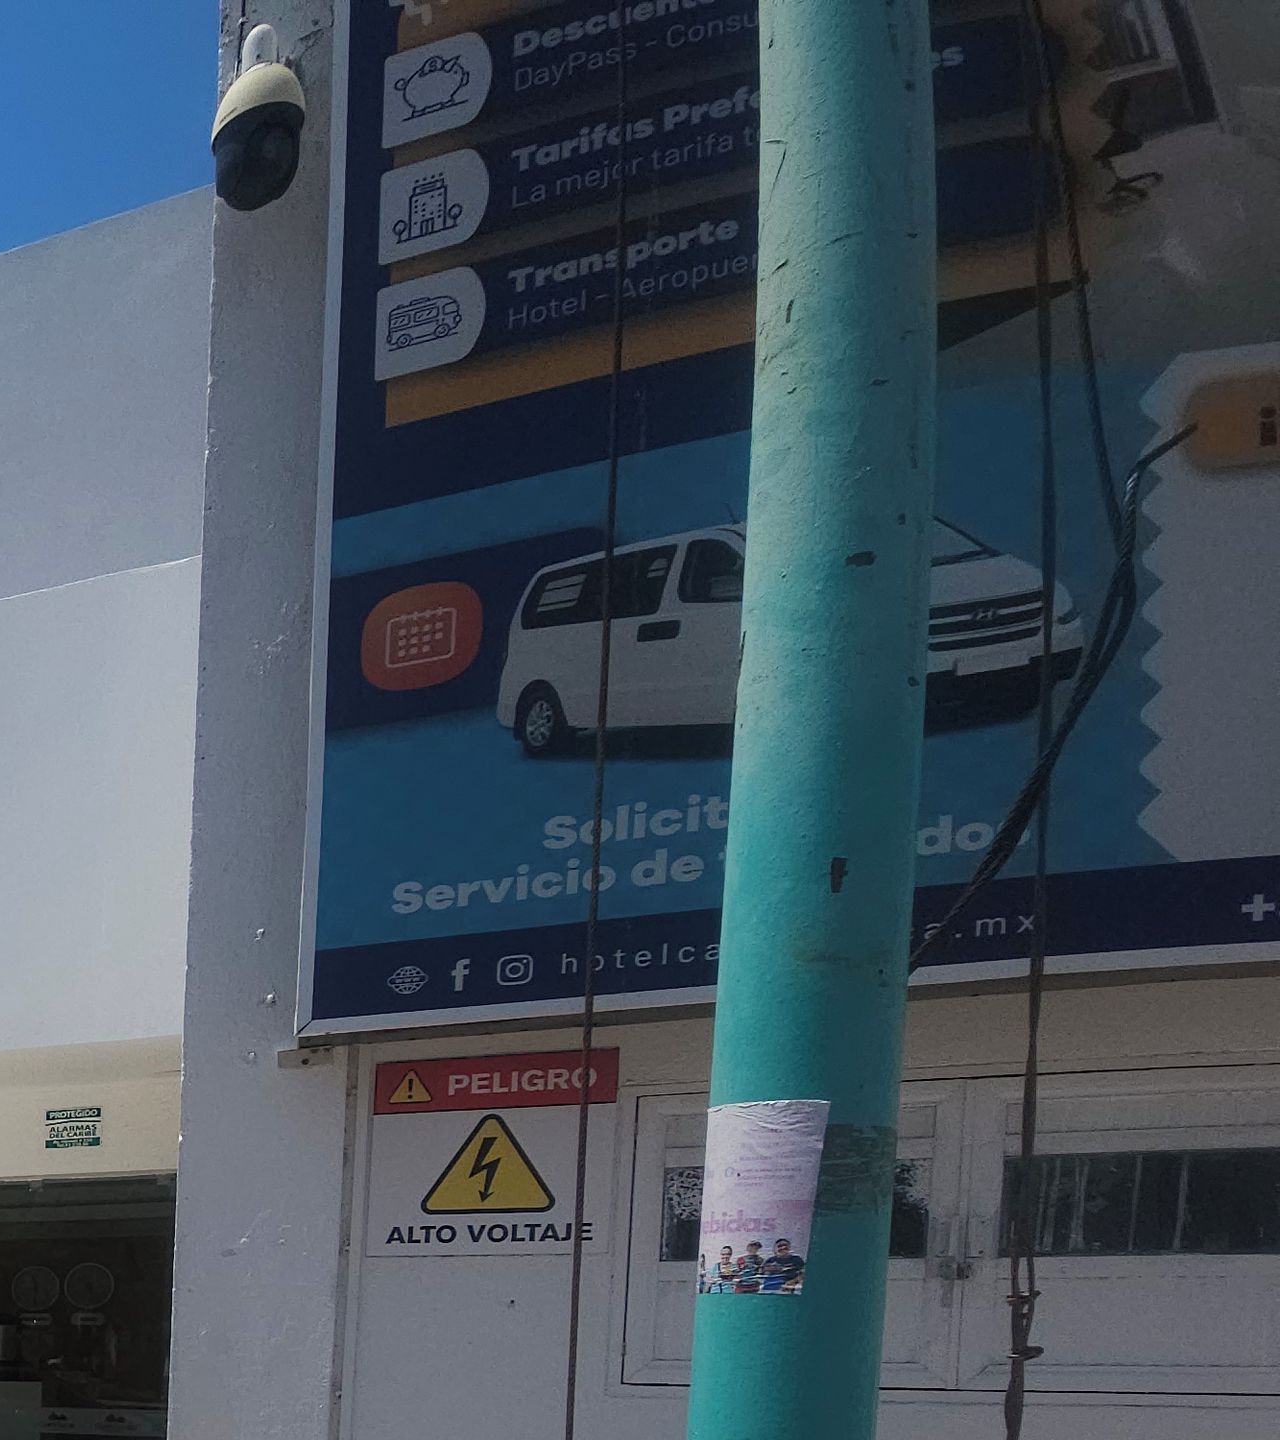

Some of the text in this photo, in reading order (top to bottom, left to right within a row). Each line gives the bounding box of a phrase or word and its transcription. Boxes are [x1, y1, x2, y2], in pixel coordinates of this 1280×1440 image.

[665, 11, 758, 48] Consu
[511, 114, 655, 173] Tarifas
[511, 170, 546, 209] La
[650, 130, 734, 170] tarifa
[507, 218, 740, 293] Transporte
[507, 289, 587, 330] Hotel
[542, 794, 730, 850] Solicit
[391, 857, 617, 915] Servicio
[630, 848, 705, 888] de
[447, 1067, 598, 1097] PELIGRO
[49, 1109, 97, 1119] PROTEGIDO
[50, 1124, 97, 1132] ALARMAS
[385, 1222, 593, 1245] ALTO VOLTAJE
